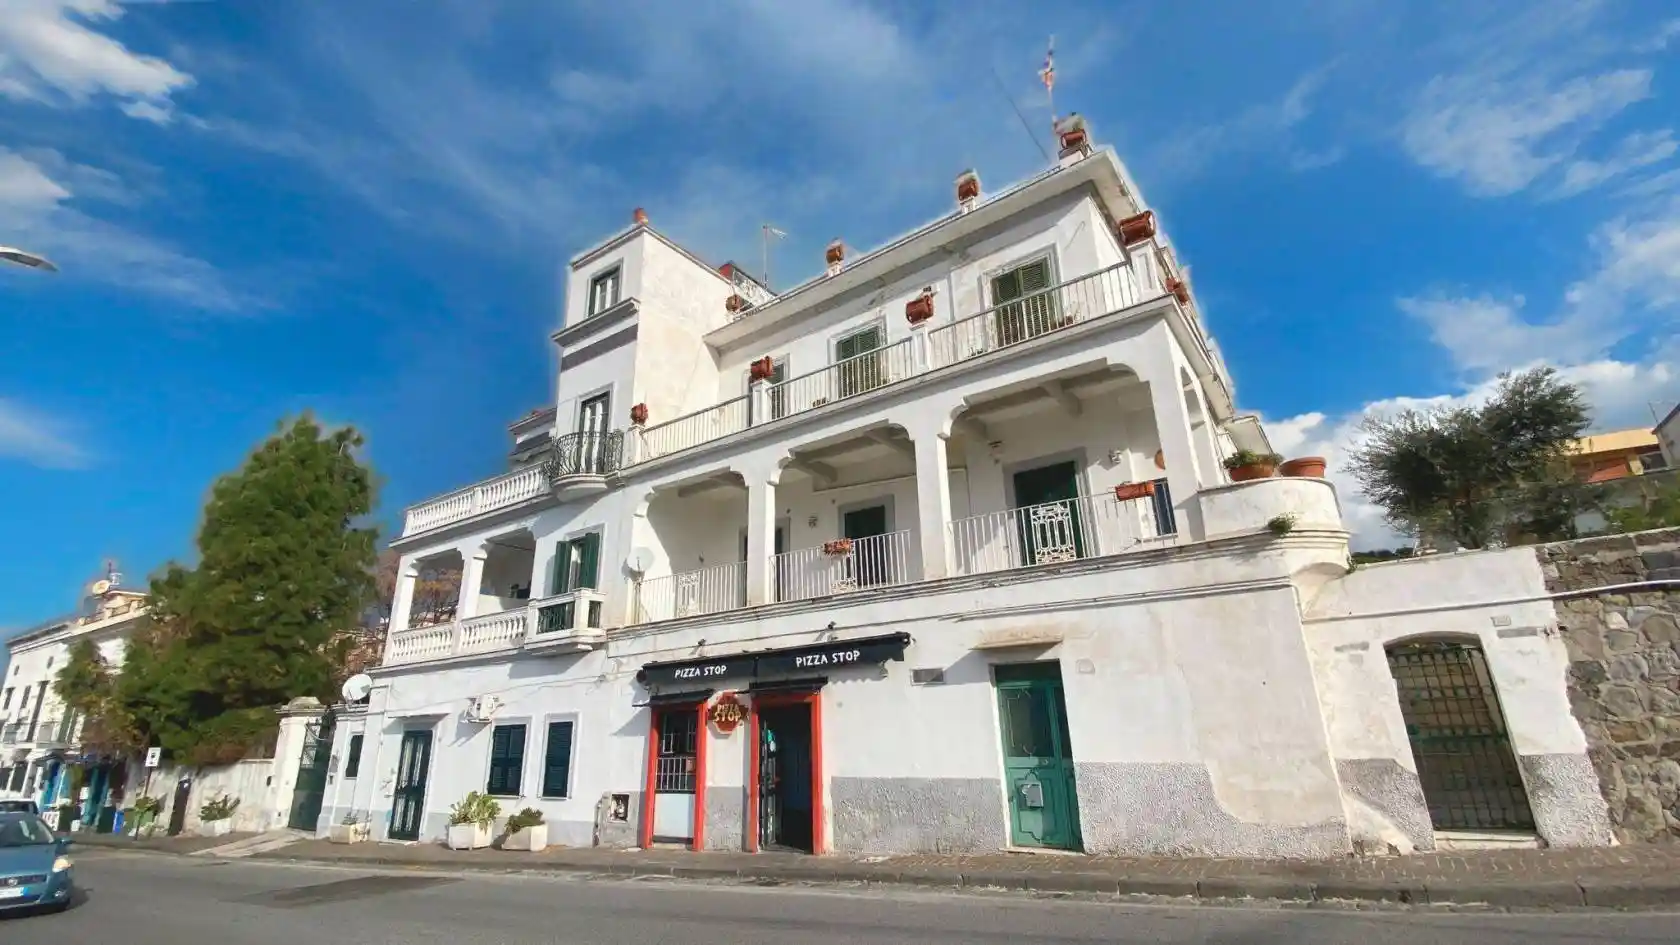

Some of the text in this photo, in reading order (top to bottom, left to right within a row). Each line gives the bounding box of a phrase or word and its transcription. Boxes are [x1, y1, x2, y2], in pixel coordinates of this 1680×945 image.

[796, 650, 861, 668] PIZZA STOP
[674, 665, 728, 679] PIZZA STOP
[715, 711, 741, 722] STOP
